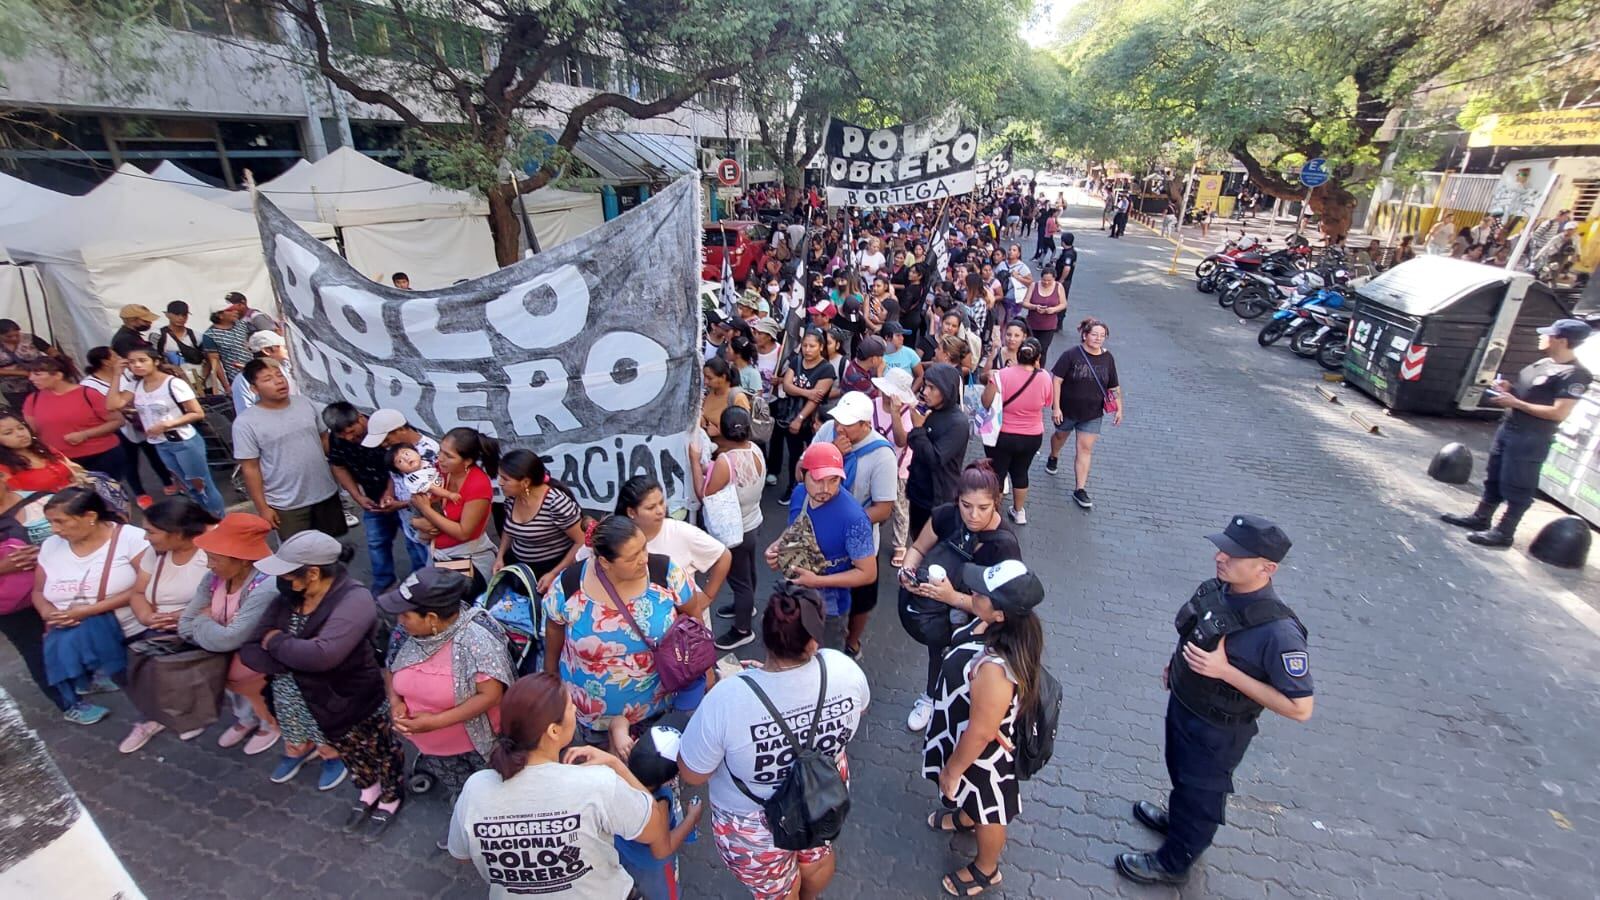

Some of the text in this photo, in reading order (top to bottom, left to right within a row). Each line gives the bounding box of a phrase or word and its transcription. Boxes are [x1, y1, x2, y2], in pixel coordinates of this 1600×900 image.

[842, 112, 960, 160] POLO
[830, 133, 977, 182] OBRERO
[724, 164, 735, 180] E
[865, 179, 950, 204] ORTEGA
[274, 233, 590, 360] POLO
[286, 320, 668, 440] OBRERO
[477, 817, 578, 838] CONGRESO
[480, 831, 578, 851] NACIONAL DEL
[481, 850, 559, 868] POLO
[489, 859, 585, 882] OBRERO
